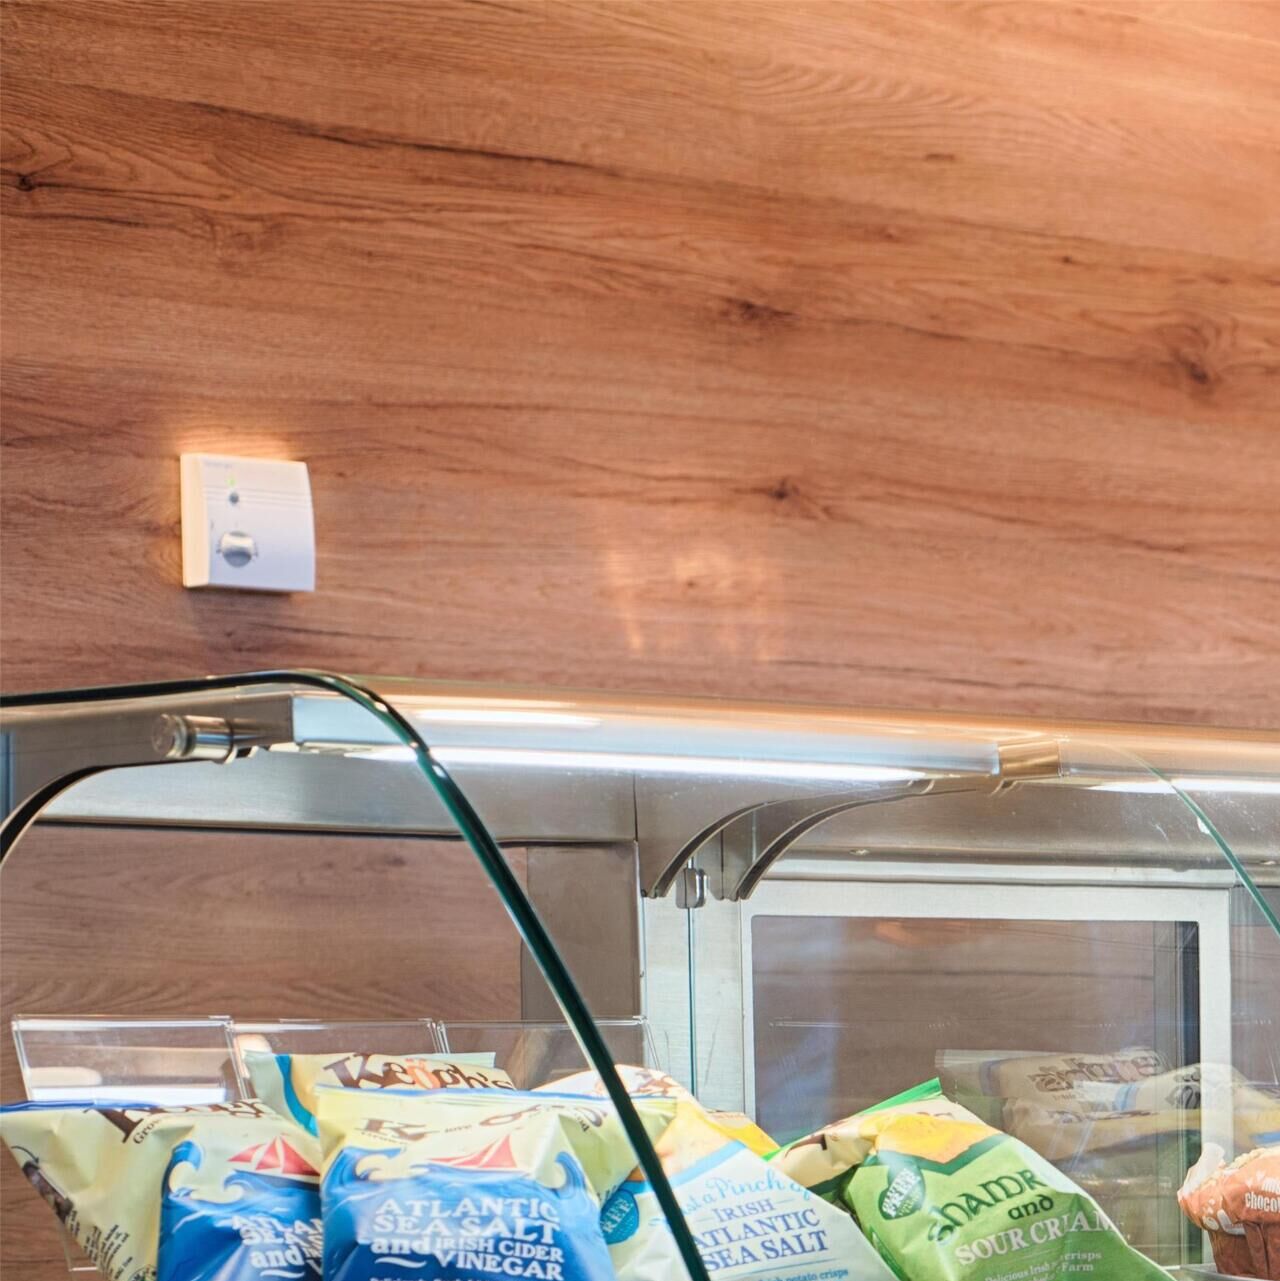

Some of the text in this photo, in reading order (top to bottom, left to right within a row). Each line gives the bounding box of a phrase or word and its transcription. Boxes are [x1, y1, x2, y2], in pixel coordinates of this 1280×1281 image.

[706, 1169, 783, 1201] Pinch
[374, 1198, 559, 1223] ATLANTIC
[714, 1199, 775, 1222] IRISH
[1008, 1195, 1053, 1220] and
[372, 1215, 561, 1244] SEA SALT
[692, 1208, 821, 1250] ATLANTIC
[250, 1245, 305, 1267] and
[371, 1236, 431, 1254] and
[434, 1236, 563, 1263] IRISH CIDER
[703, 1230, 829, 1272] SEA SALT
[955, 1228, 1027, 1266] SOUR
[1064, 1251, 1102, 1262] crisps
[434, 1251, 563, 1281] VINEGAR
[1061, 1263, 1094, 1272] Farm
